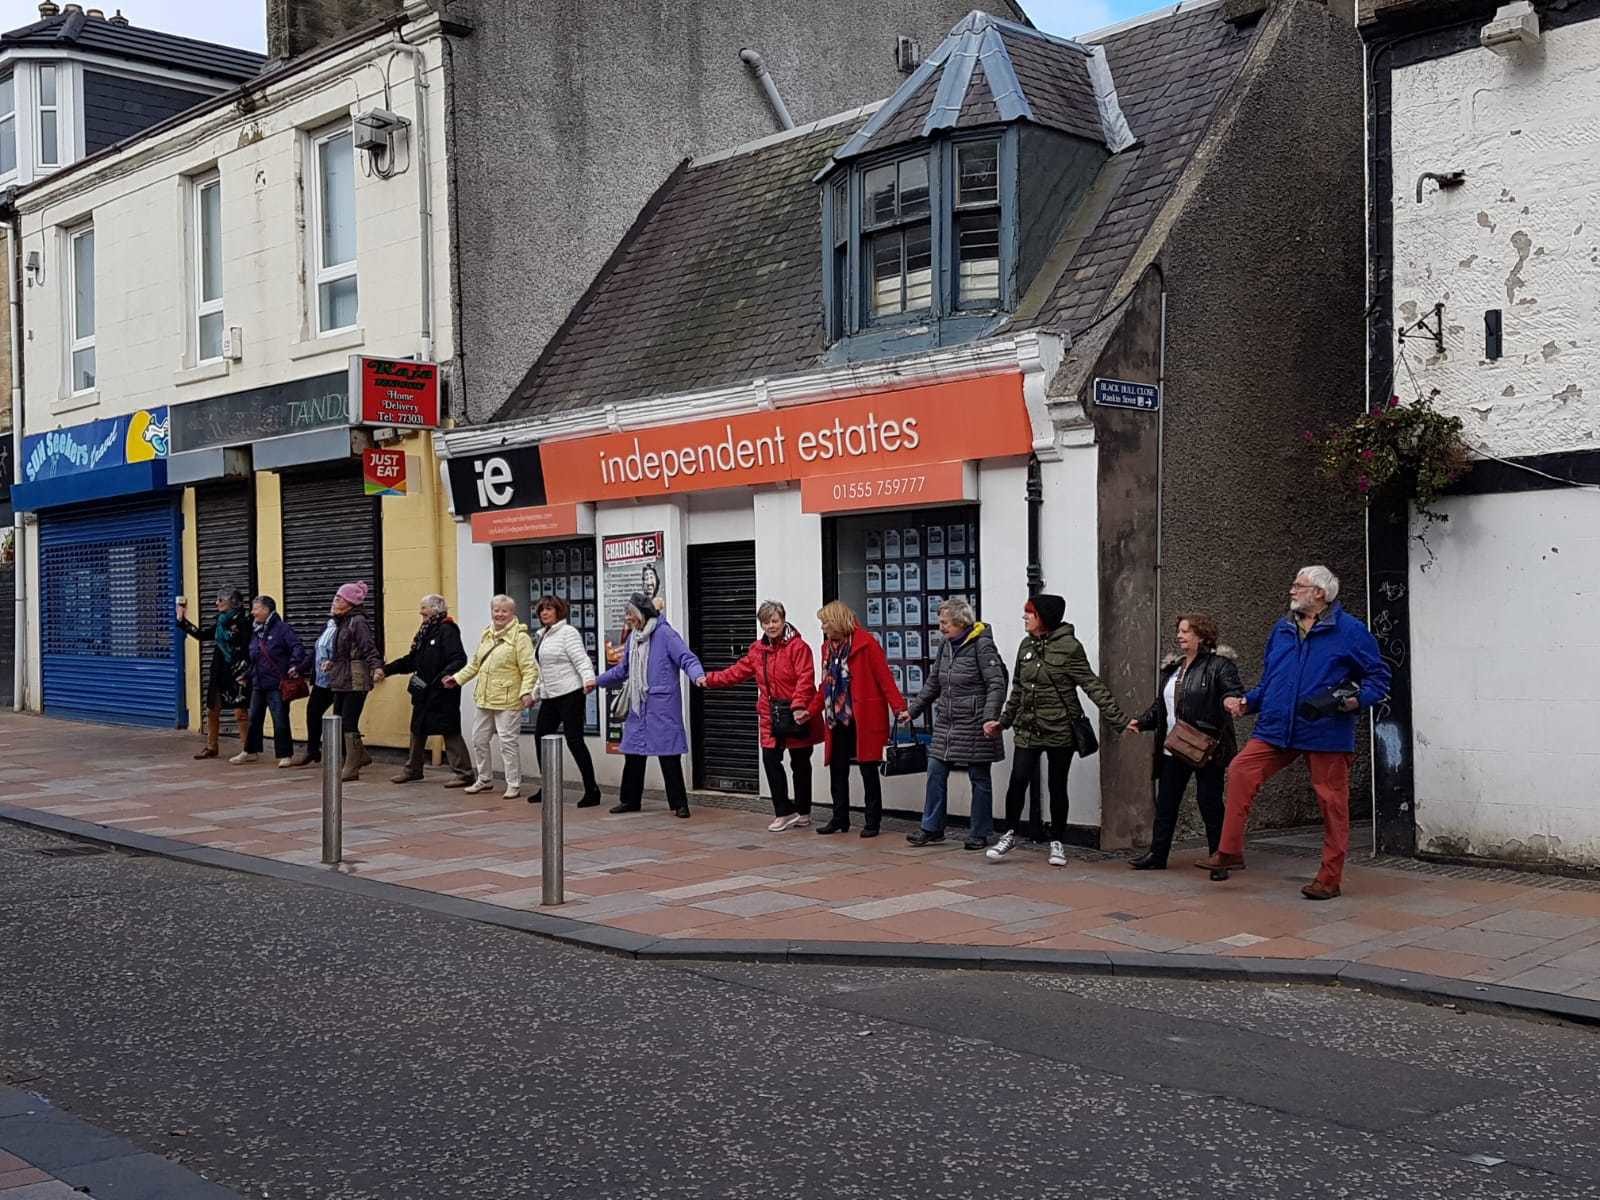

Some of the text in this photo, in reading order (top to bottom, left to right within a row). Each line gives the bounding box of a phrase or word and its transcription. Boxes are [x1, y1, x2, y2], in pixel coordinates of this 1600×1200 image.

[386, 390, 414, 401] Home
[383, 400, 418, 413] Delivery
[398, 413, 424, 425] 773031
[600, 412, 920, 488] independent estates
[370, 453, 399, 466] JUST
[376, 466, 400, 477] EAT
[474, 457, 514, 507] ie
[833, 476, 925, 500] 01555 759777
[605, 540, 644, 560] CHALLENGE
